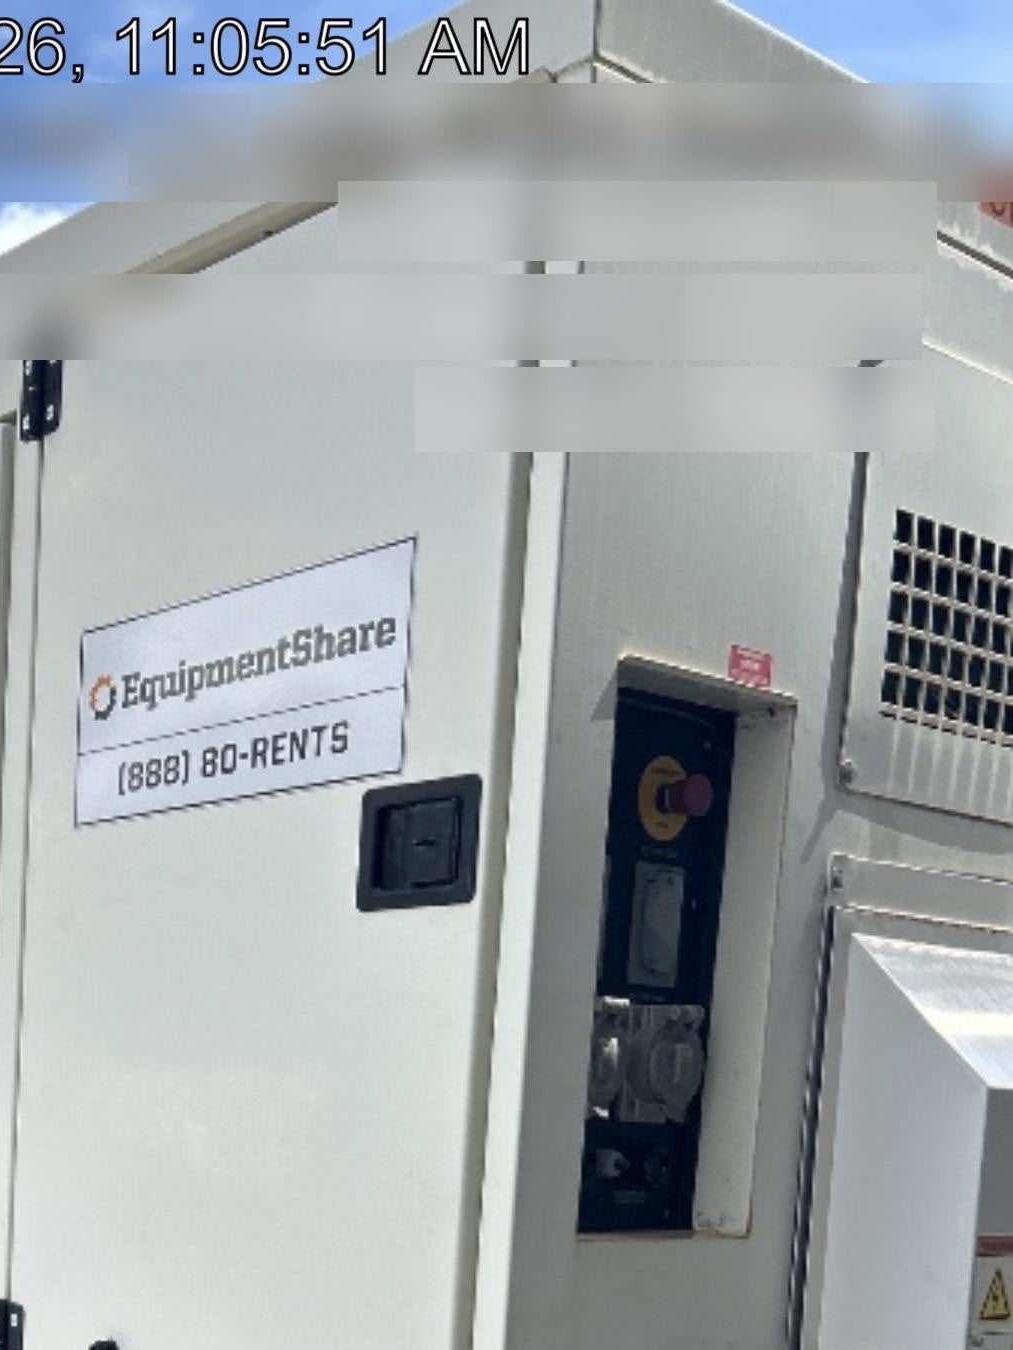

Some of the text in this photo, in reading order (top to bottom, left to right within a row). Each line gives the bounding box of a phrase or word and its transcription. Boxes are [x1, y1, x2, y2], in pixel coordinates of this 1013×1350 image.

[120, 616, 397, 712] EquipmentShare
[117, 720, 351, 796] (888) 80-RENTS
